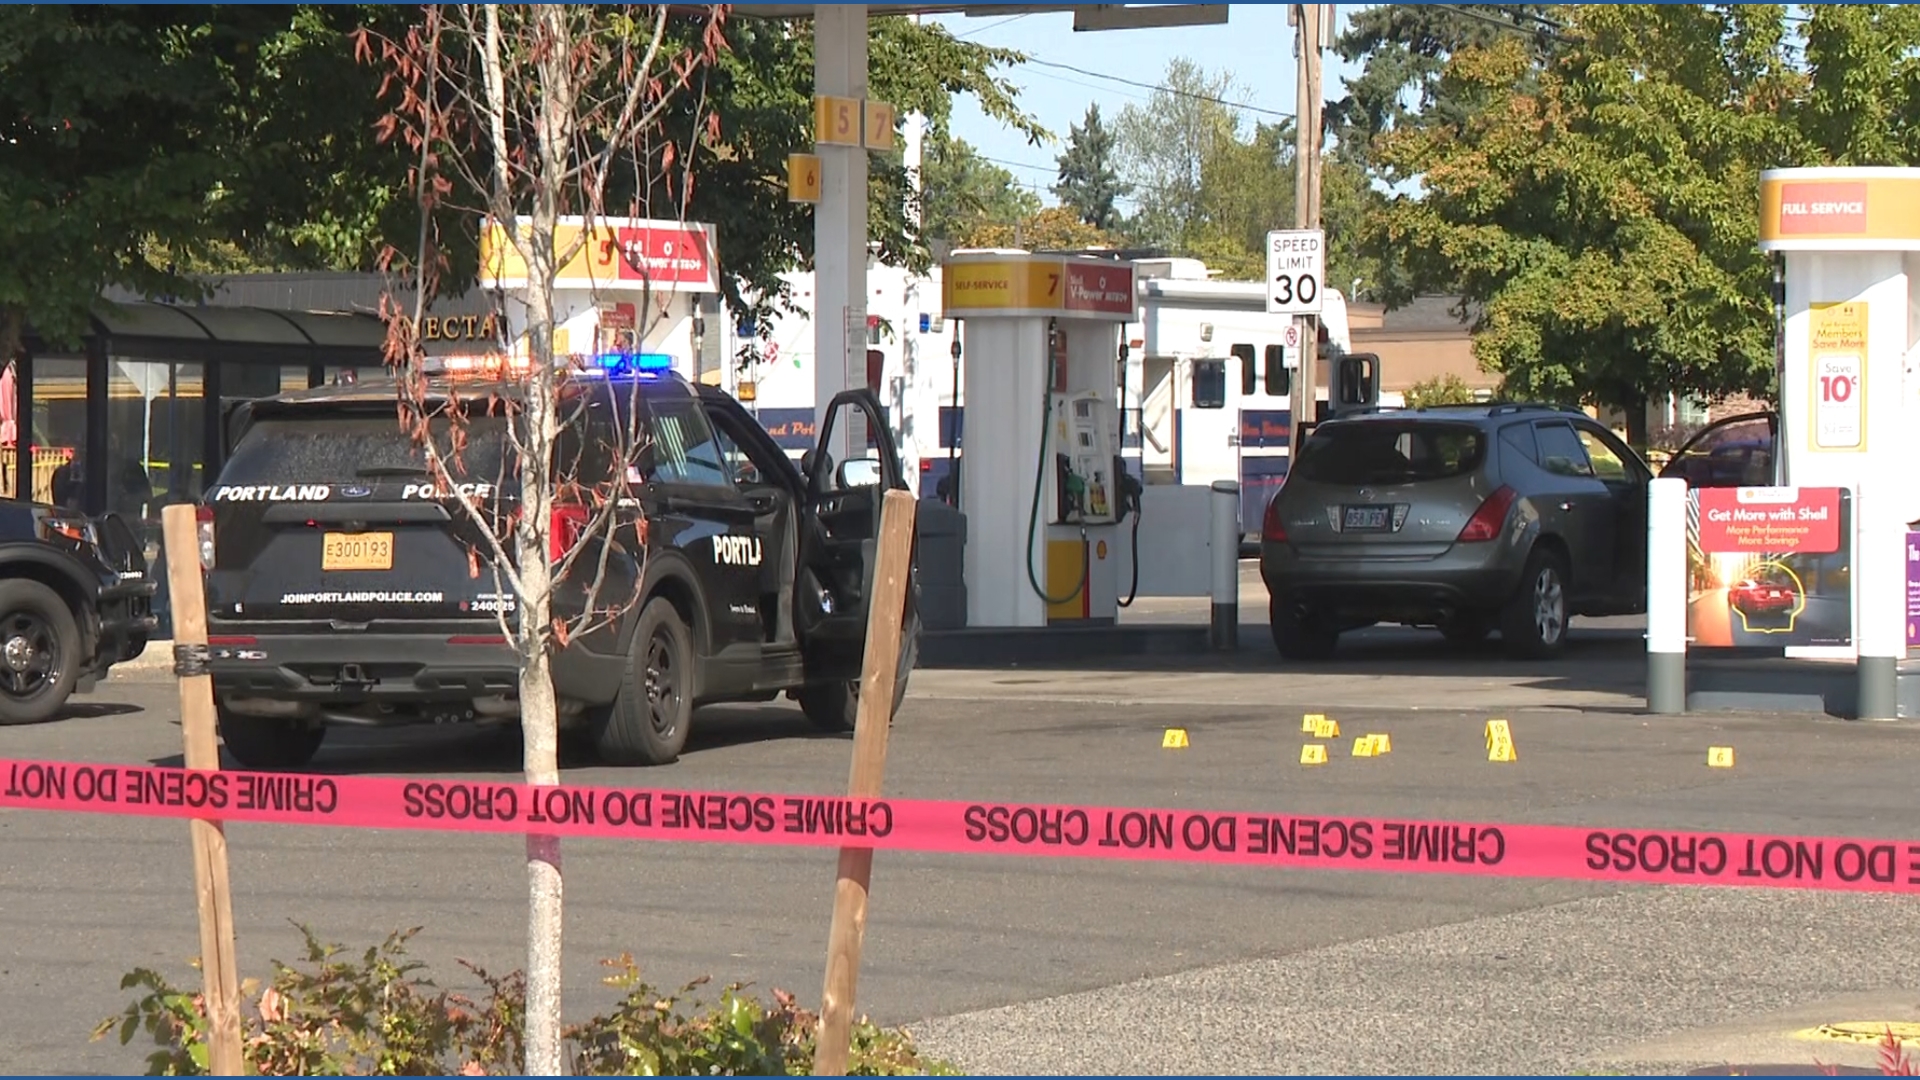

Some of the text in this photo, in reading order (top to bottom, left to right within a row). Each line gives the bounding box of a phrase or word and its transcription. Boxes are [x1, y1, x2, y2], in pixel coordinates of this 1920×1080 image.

[838, 106, 849, 134] 5
[876, 113, 886, 139] 7
[807, 170, 815, 186] 6
[1782, 202, 1864, 215] FULL SERVICE
[598, 240, 612, 265] 5
[1273, 239, 1318, 252] SPEED
[1278, 256, 1313, 269] LIMIT
[955, 280, 1009, 290] SELF-SERVICE
[1048, 274, 1059, 297] 7
[1071, 285, 1105, 301] V-Power
[1274, 274, 1317, 304] 30
[1817, 328, 1862, 338] Members
[1813, 340, 1865, 349] Save More
[1825, 363, 1851, 373] Save
[216, 485, 330, 501] PORTLAND
[1708, 506, 1828, 522] Get More with Shell
[1726, 524, 1809, 535] More Performance
[327, 541, 388, 557] E300193
[1738, 536, 1799, 547] More Savings
[280, 592, 443, 604] JOINPORTLANDPOLICE.COM
[1308, 750, 1315, 759] 4
[5, 764, 338, 812] CRIME SCENE DO NOT
[403, 783, 893, 837] CRIME SCENE DO NOT CROSS
[963, 806, 1506, 866] CRIME SCENE DO NOT CROSS
[1585, 832, 1727, 876] CROSS
[1738, 839, 1824, 880] NOT
[1834, 843, 1896, 884] DO
